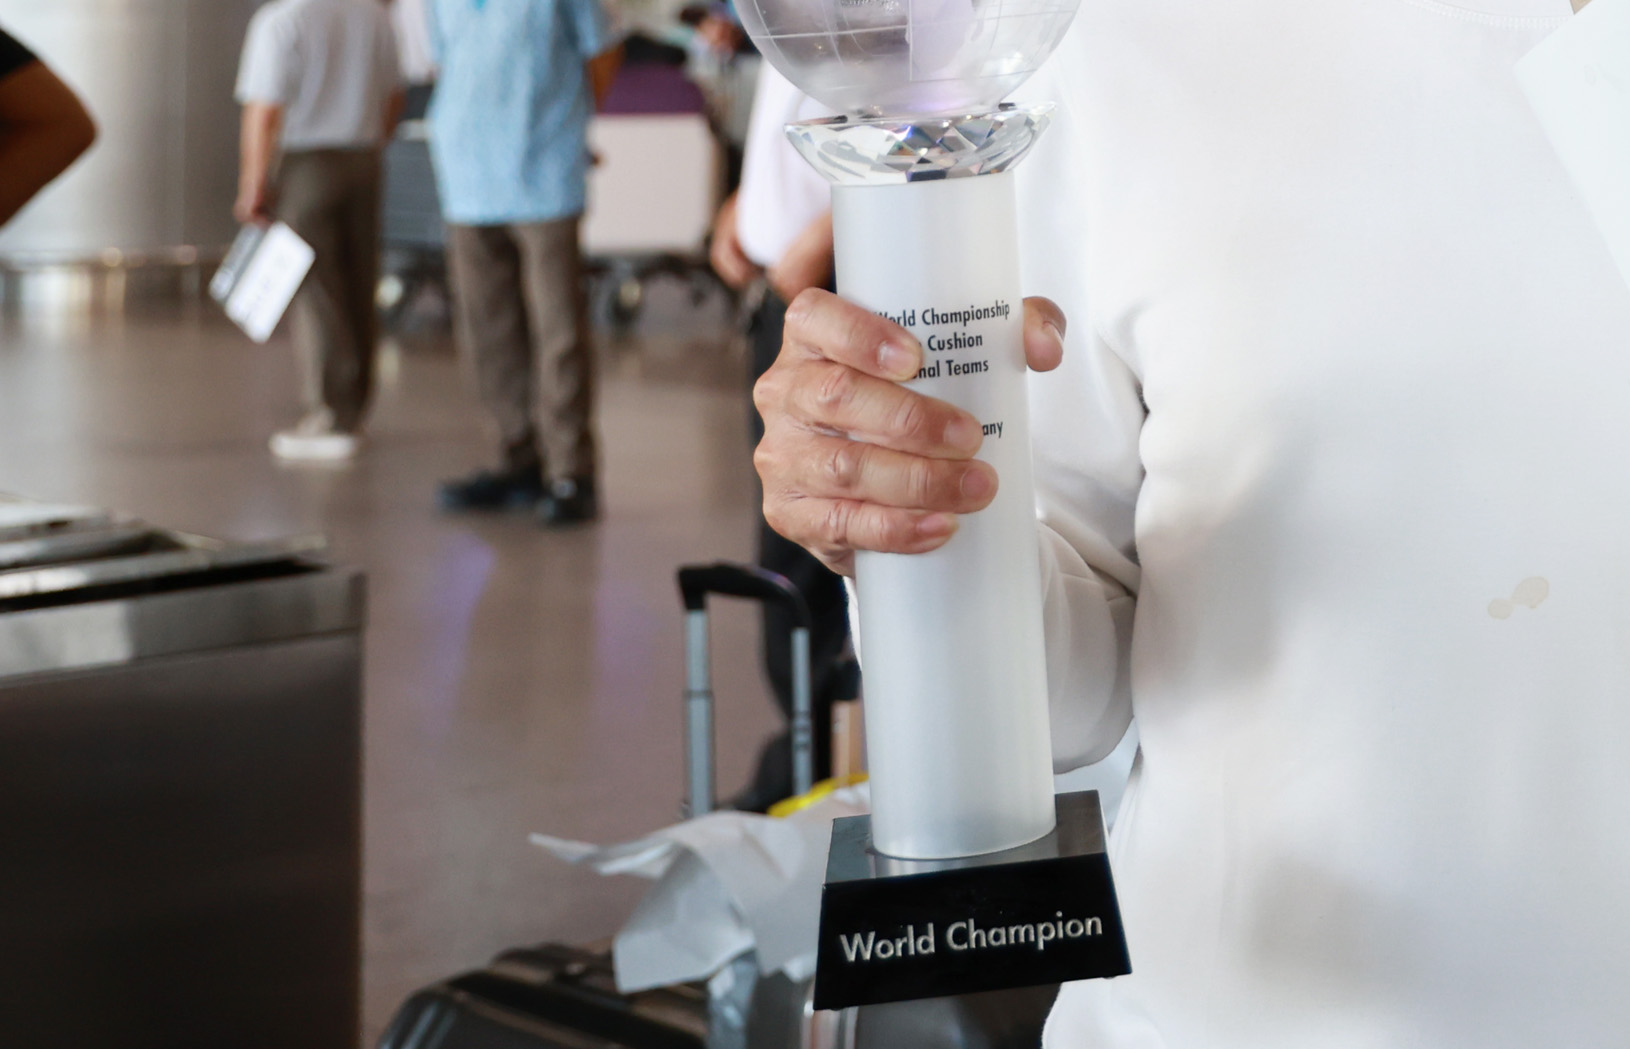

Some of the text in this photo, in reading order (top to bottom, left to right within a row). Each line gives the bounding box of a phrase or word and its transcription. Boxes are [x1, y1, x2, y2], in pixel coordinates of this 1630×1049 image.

[922, 300, 1010, 327] Championship
[927, 332, 983, 351] Cushion
[913, 359, 989, 379] nal Teams
[982, 422, 1003, 438] any
[840, 911, 1103, 962] World Champion
